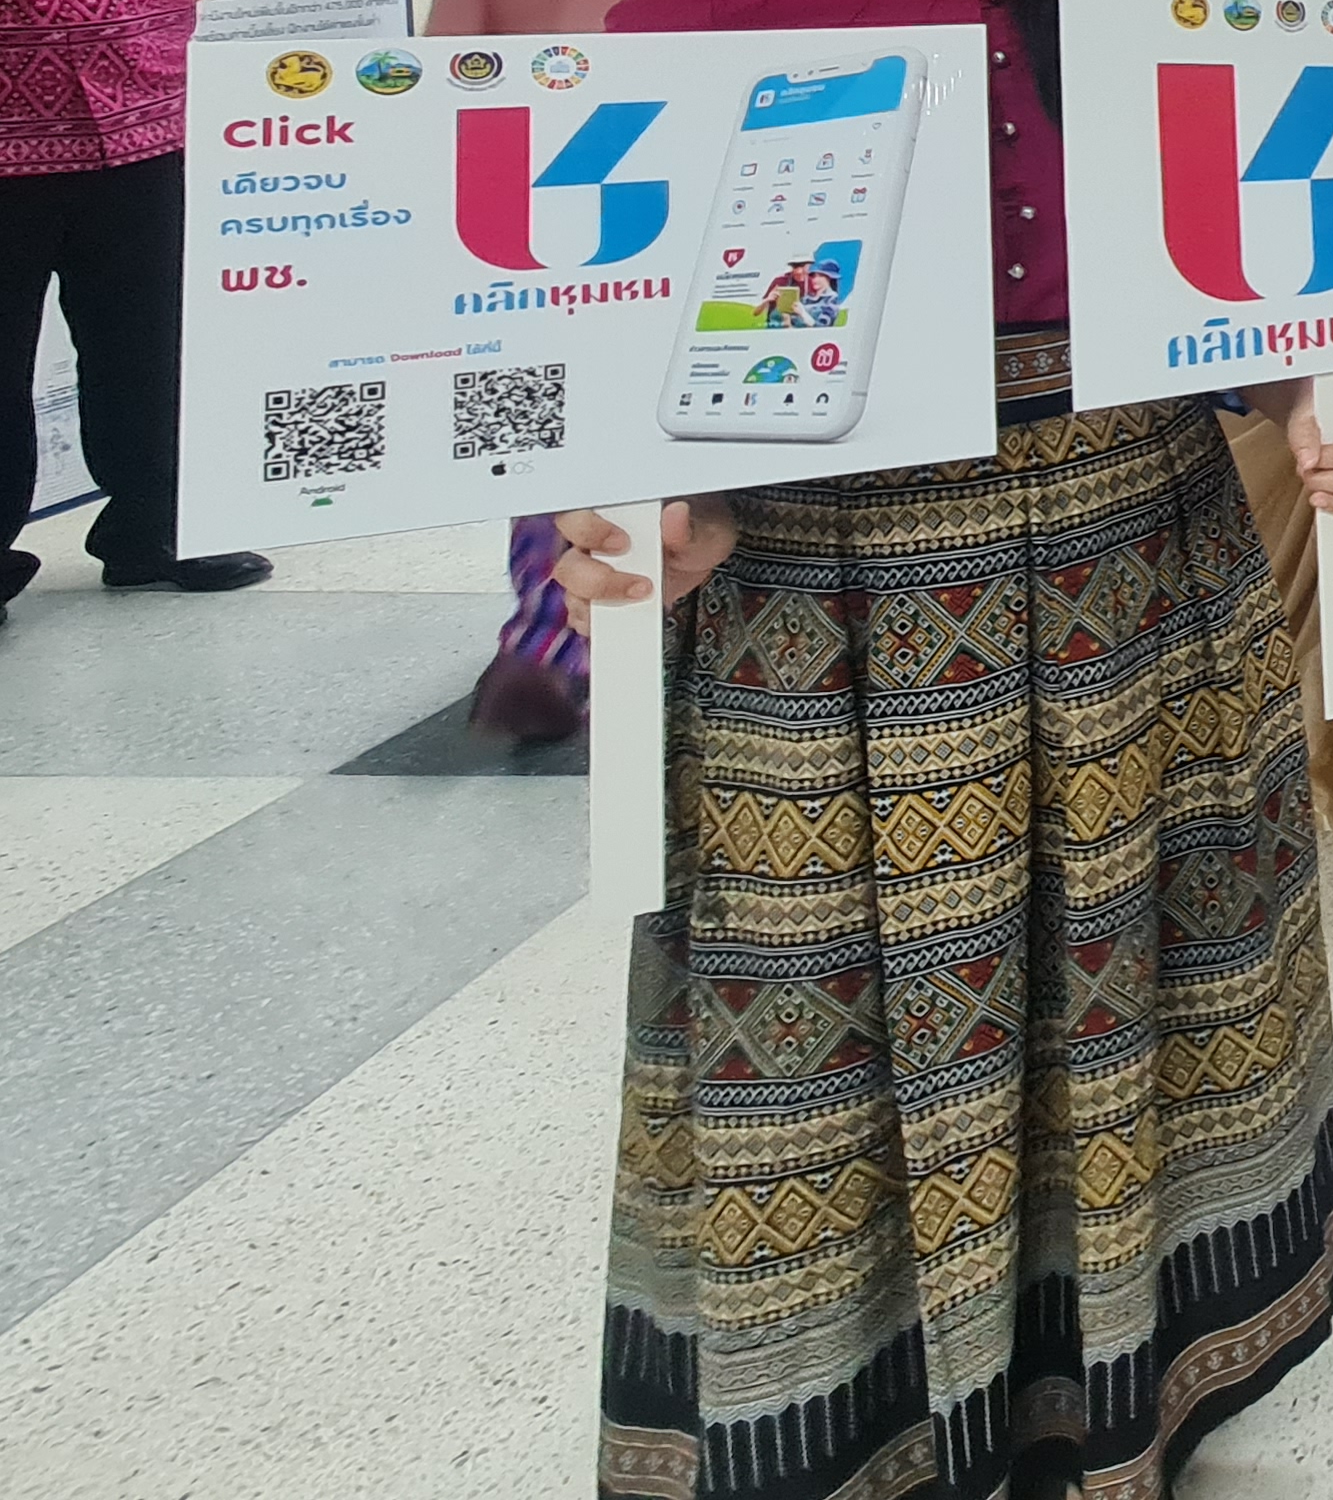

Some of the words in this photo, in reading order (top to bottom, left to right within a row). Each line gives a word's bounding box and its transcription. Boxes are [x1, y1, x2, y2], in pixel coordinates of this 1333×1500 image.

[223, 114, 355, 149] Click
[222, 171, 347, 197] เดียวจบ
[220, 201, 412, 237] ครบทุกเรื่อง
[220, 264, 308, 293] พช.
[454, 276, 672, 316] คลิกชุมชน
[390, 347, 463, 363] Download
[299, 484, 347, 497] Android
